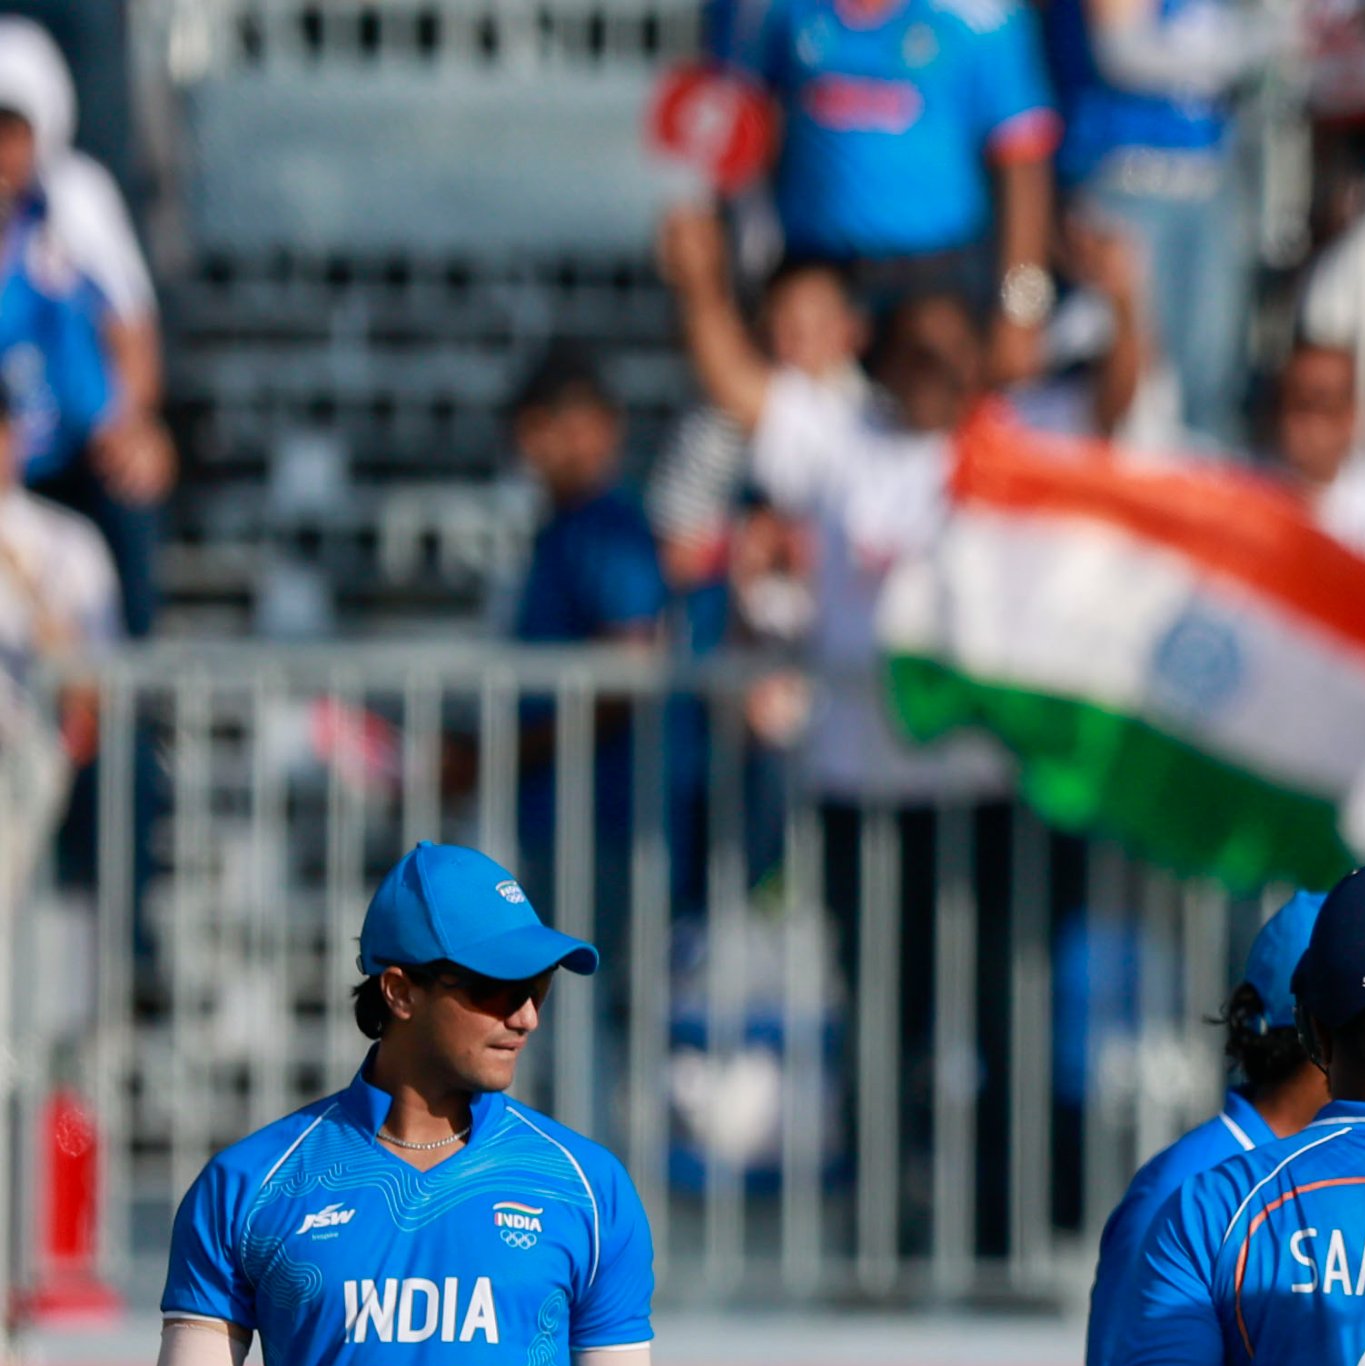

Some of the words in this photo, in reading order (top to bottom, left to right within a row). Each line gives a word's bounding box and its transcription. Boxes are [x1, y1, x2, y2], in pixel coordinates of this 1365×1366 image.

[296, 1202, 356, 1235] JSW
[494, 1211, 542, 1232] INDIA
[343, 1276, 499, 1344] INDIA
